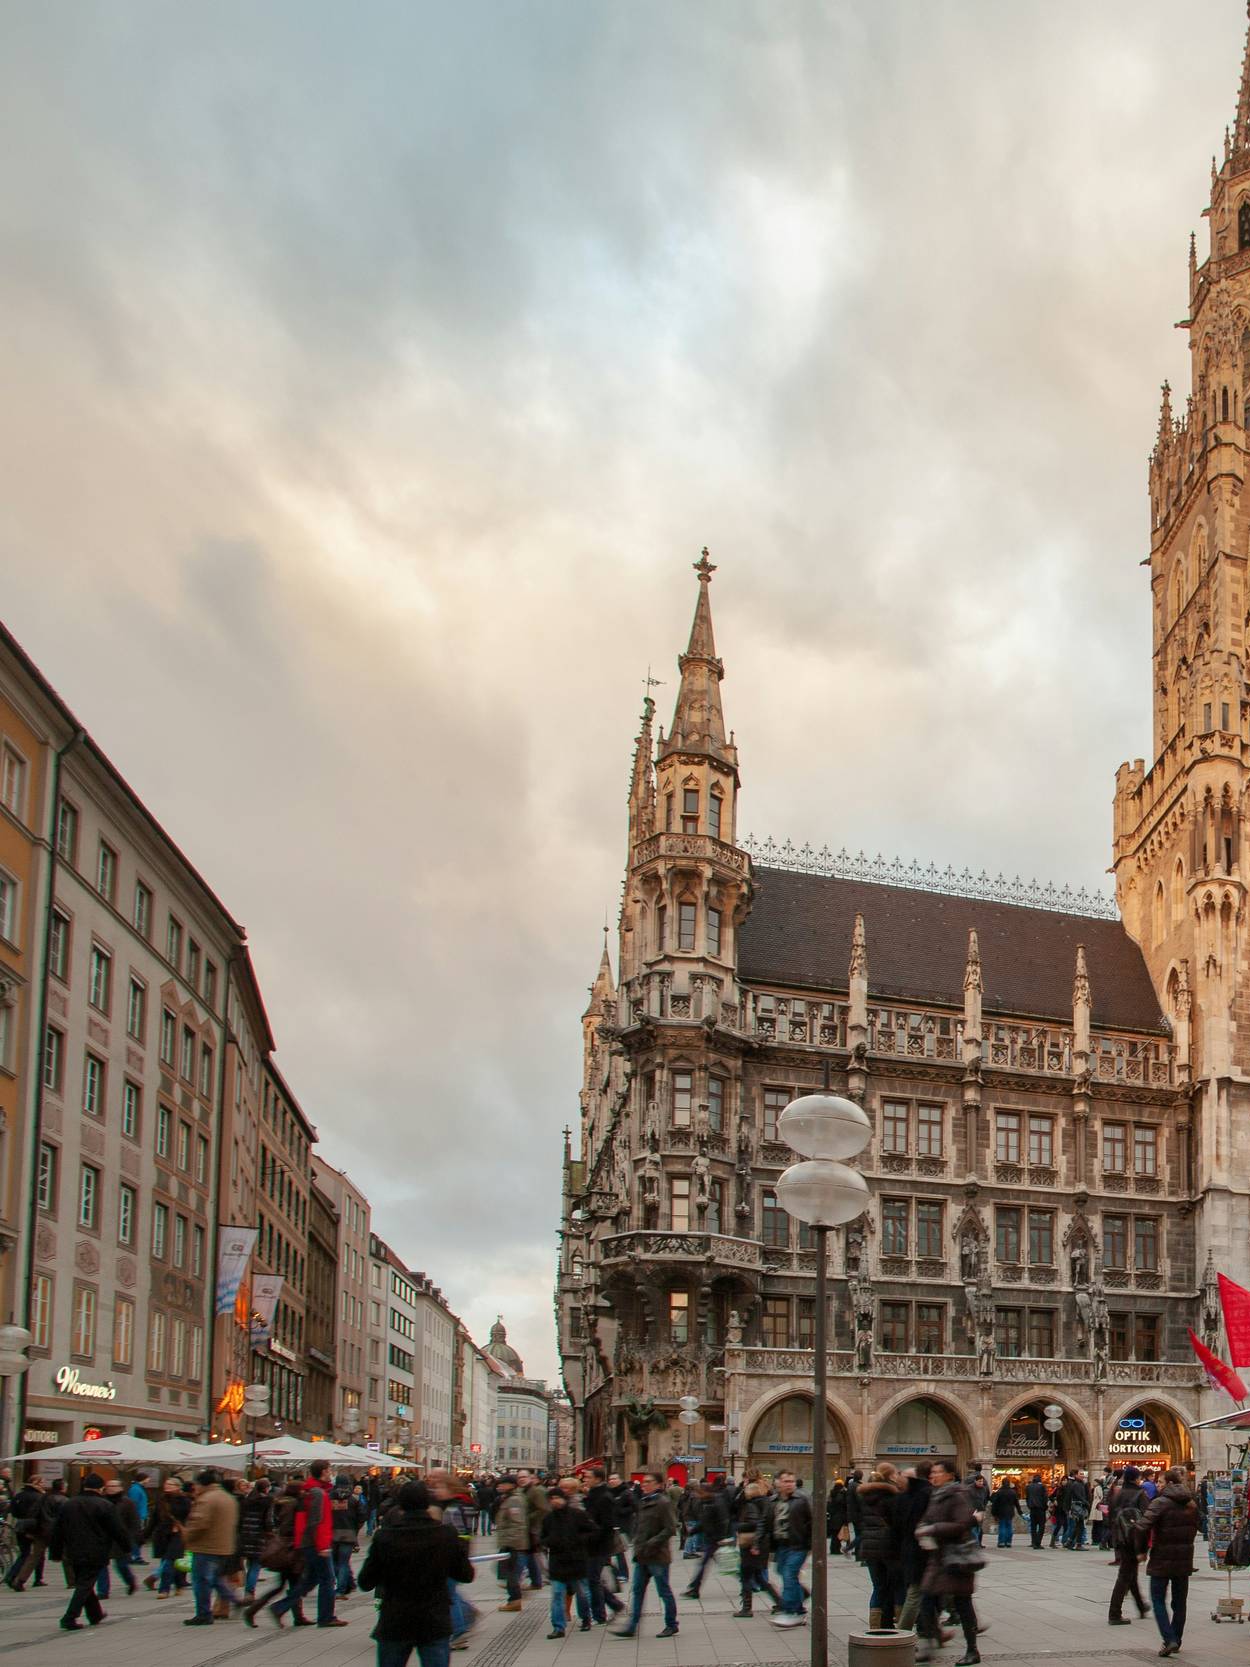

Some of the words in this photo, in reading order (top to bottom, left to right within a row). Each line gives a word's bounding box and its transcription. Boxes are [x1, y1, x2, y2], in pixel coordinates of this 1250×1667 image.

[56, 1366, 116, 1399] Woerner's
[1115, 1431, 1150, 1441] OPTIK
[768, 1443, 812, 1453] münzinger
[887, 1445, 929, 1454] münzinger
[1109, 1443, 1160, 1453] HÖRTKORN
